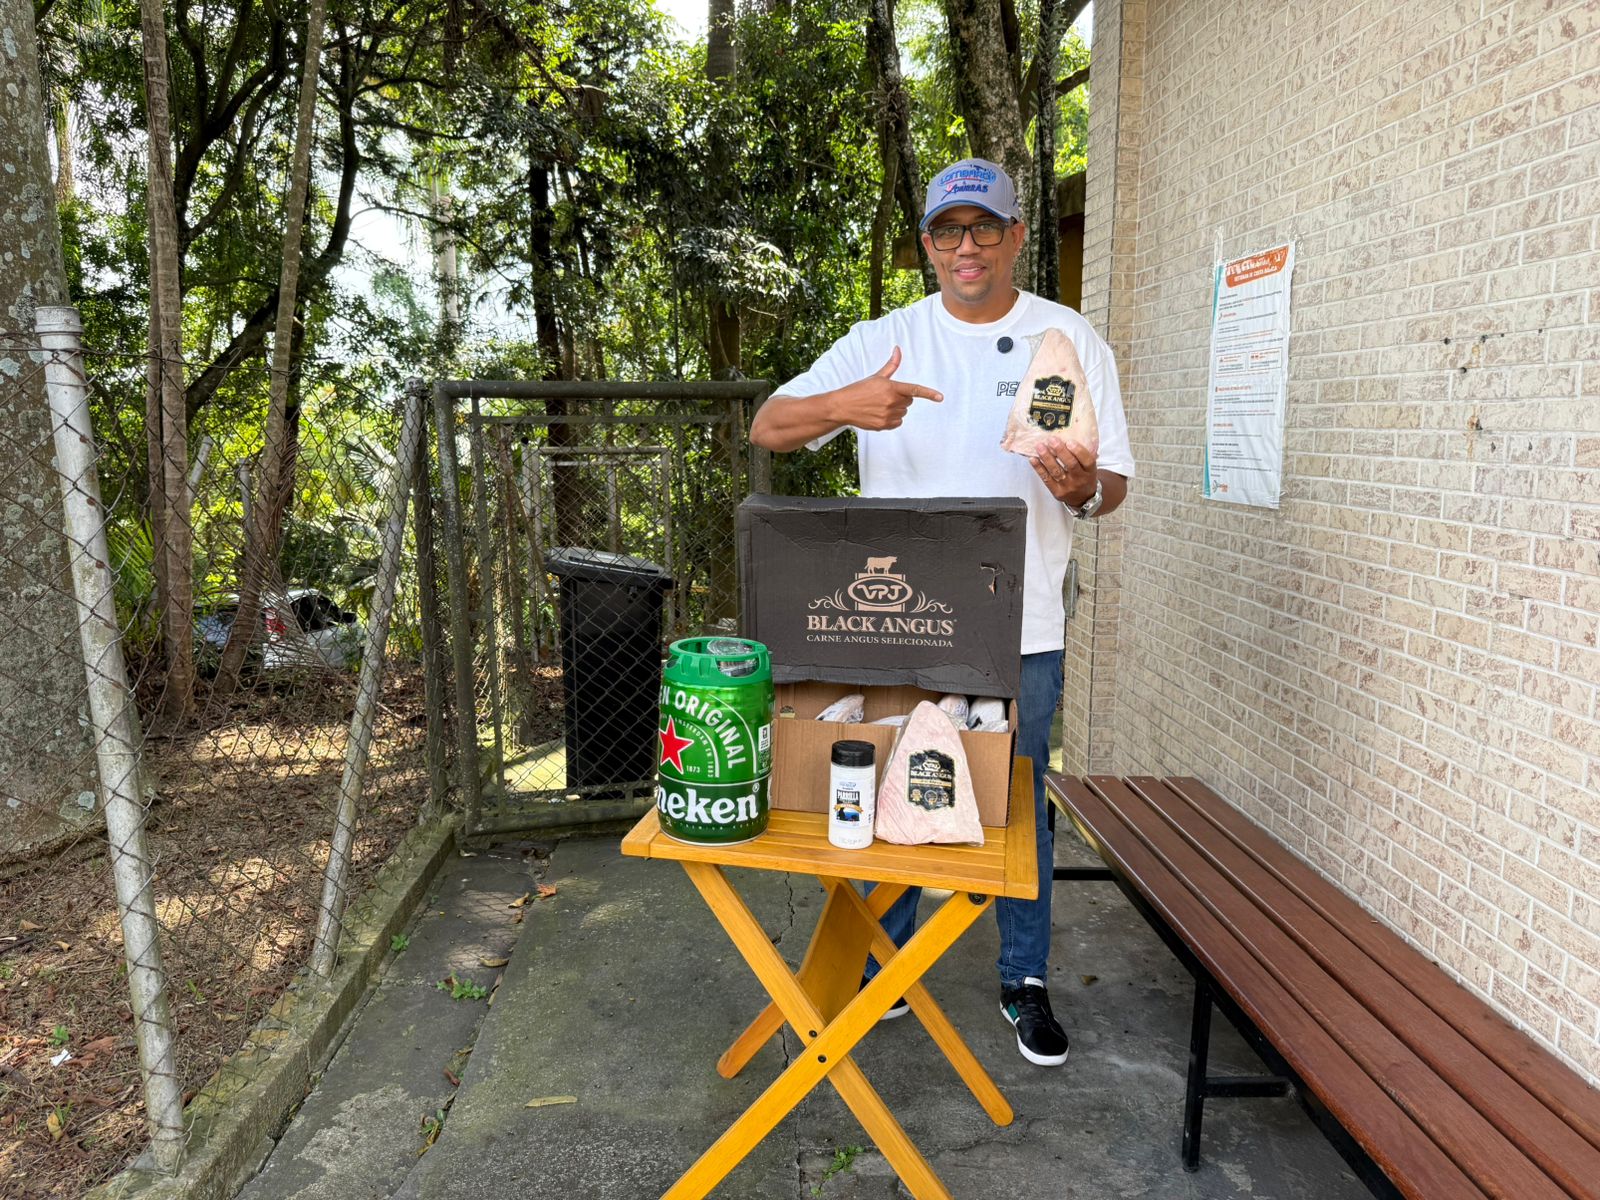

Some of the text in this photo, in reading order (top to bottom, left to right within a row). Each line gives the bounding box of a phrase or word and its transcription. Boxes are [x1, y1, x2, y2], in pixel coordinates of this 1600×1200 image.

[996, 381, 1021, 396] PE
[857, 584, 903, 601] VPJ
[806, 615, 955, 637] BLACK ANGUS
[806, 634, 954, 648] CARNE ANGUS SELECIONADA
[674, 690, 746, 769] ORIGINAL
[686, 765, 701, 774] 1873
